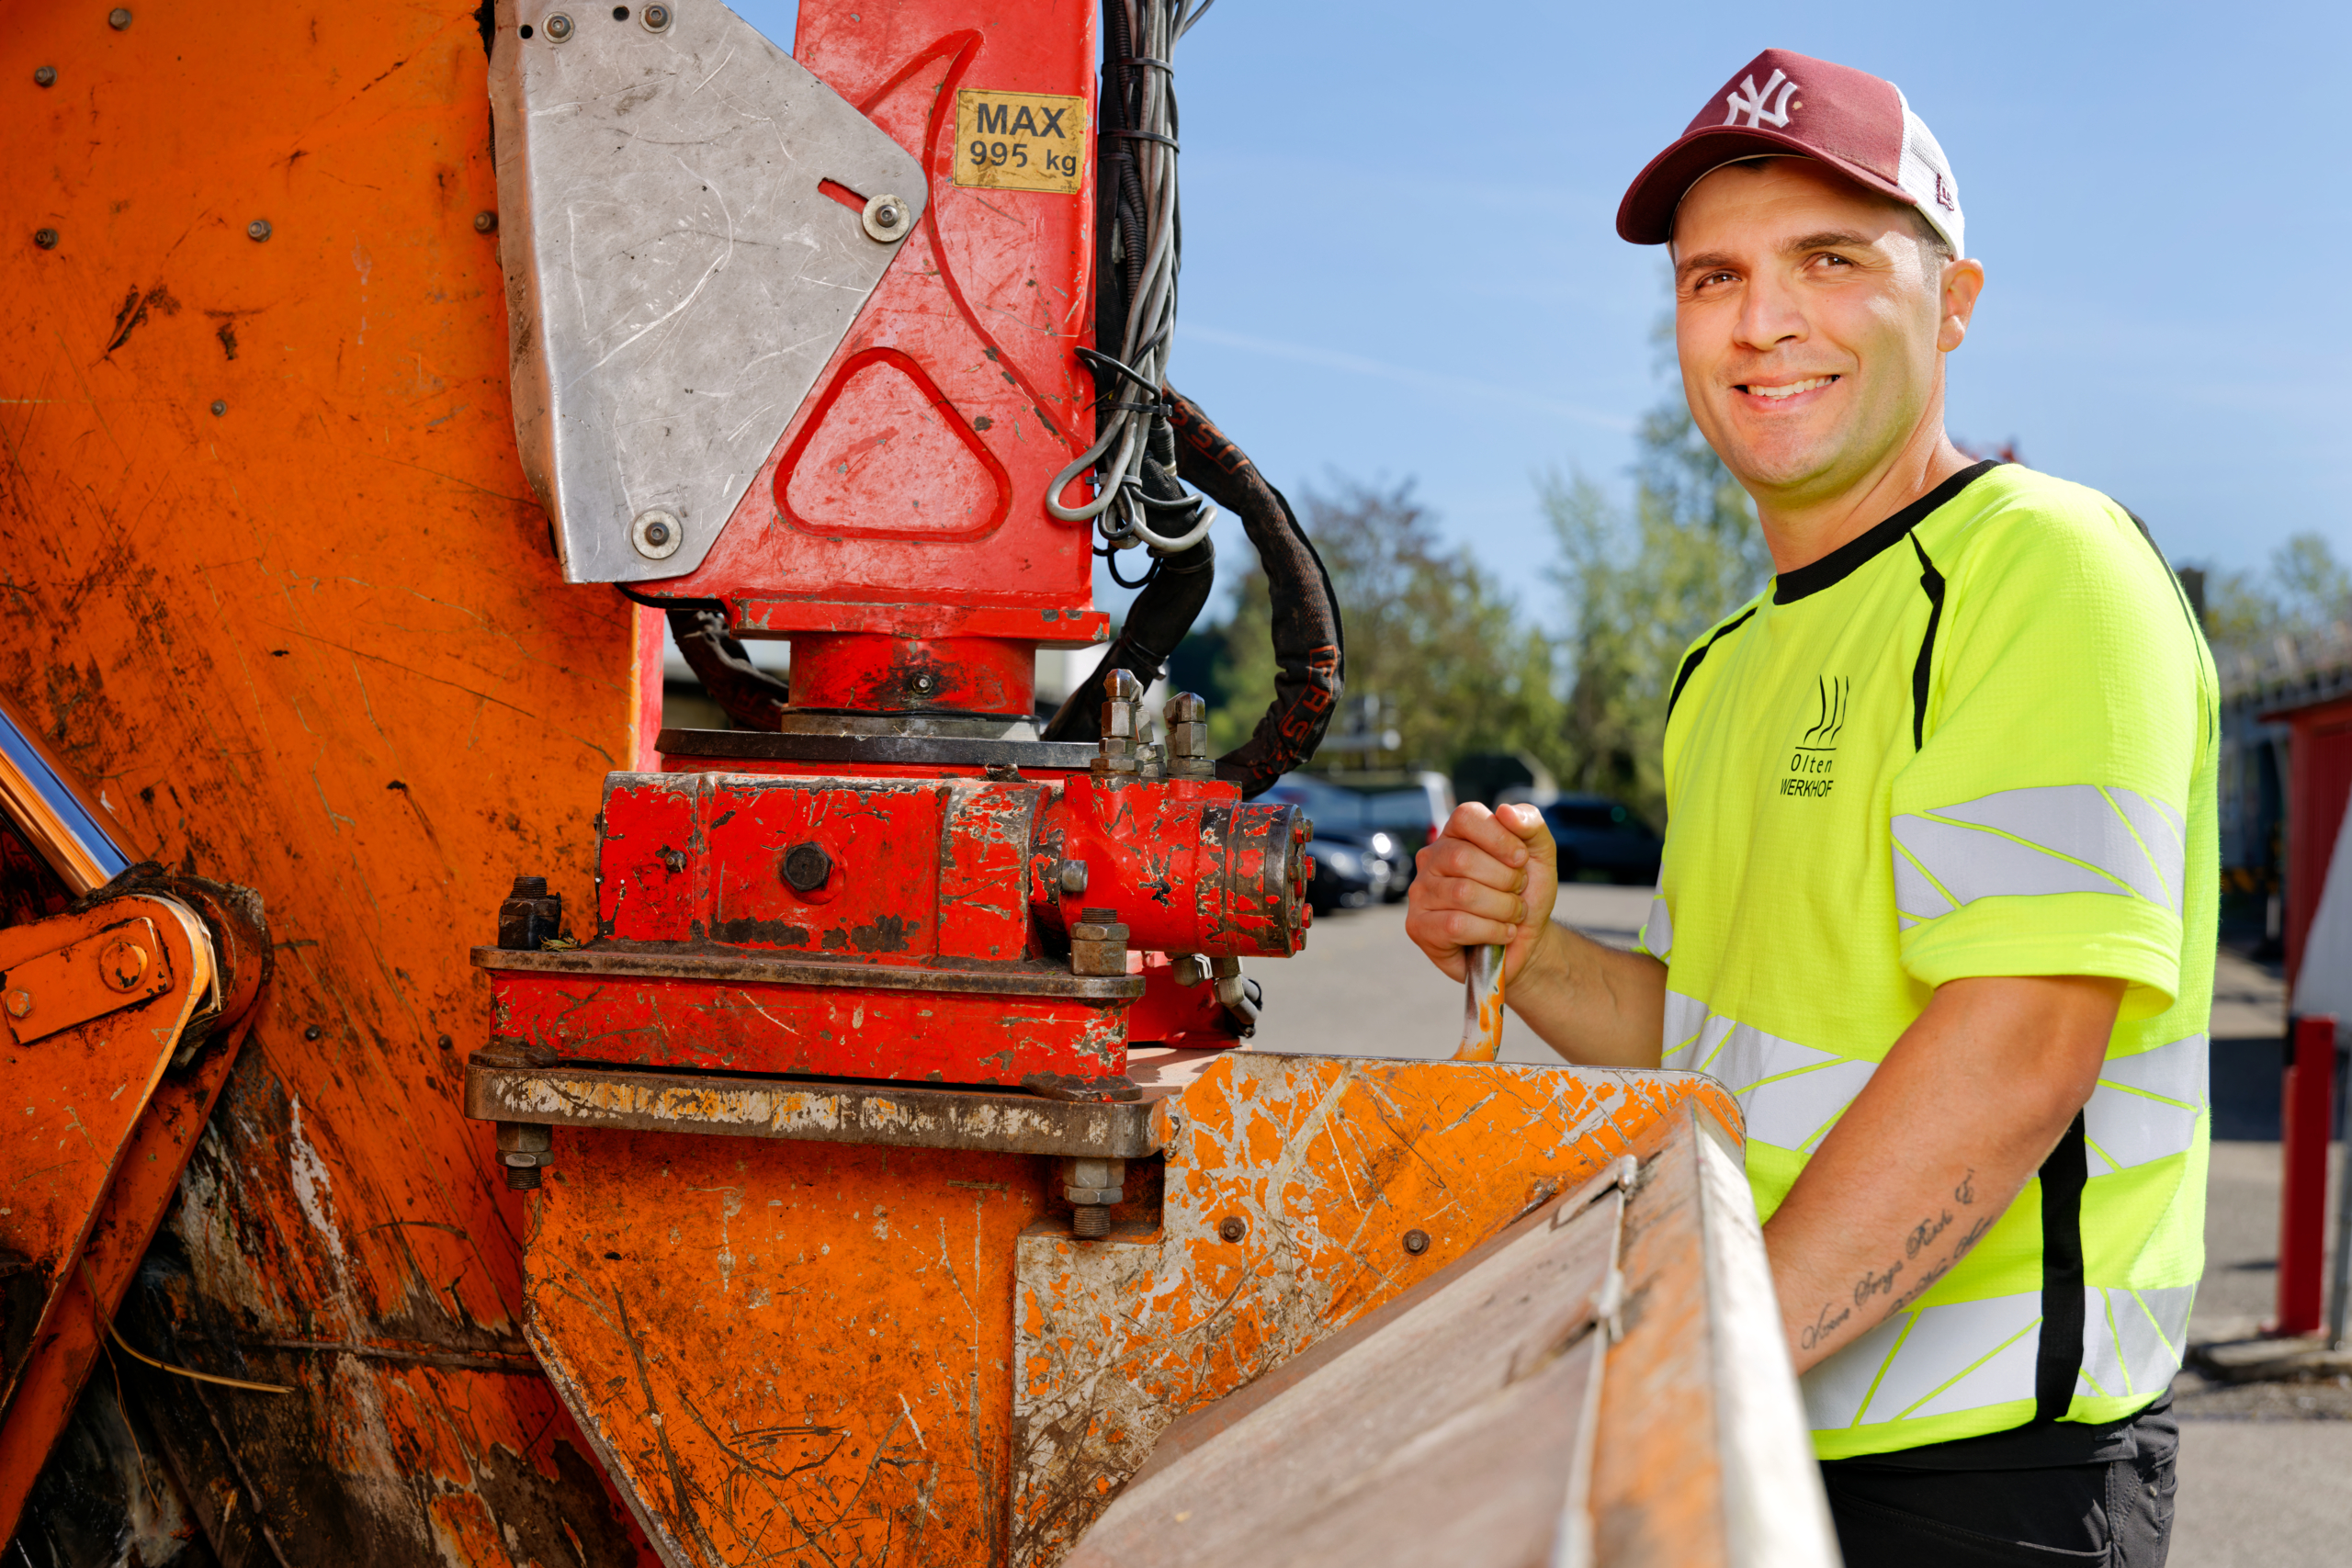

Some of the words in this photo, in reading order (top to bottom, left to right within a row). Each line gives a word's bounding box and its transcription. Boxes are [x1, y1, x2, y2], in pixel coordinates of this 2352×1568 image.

[1722, 68, 1798, 129] NY
[977, 102, 1067, 139] MAX
[970, 140, 1028, 168] 995
[1046, 149, 1077, 177] kg
[1161, 385, 1236, 460] SSI
[1791, 753, 1833, 773] Olten
[1780, 778, 1834, 797] WERKHOF
